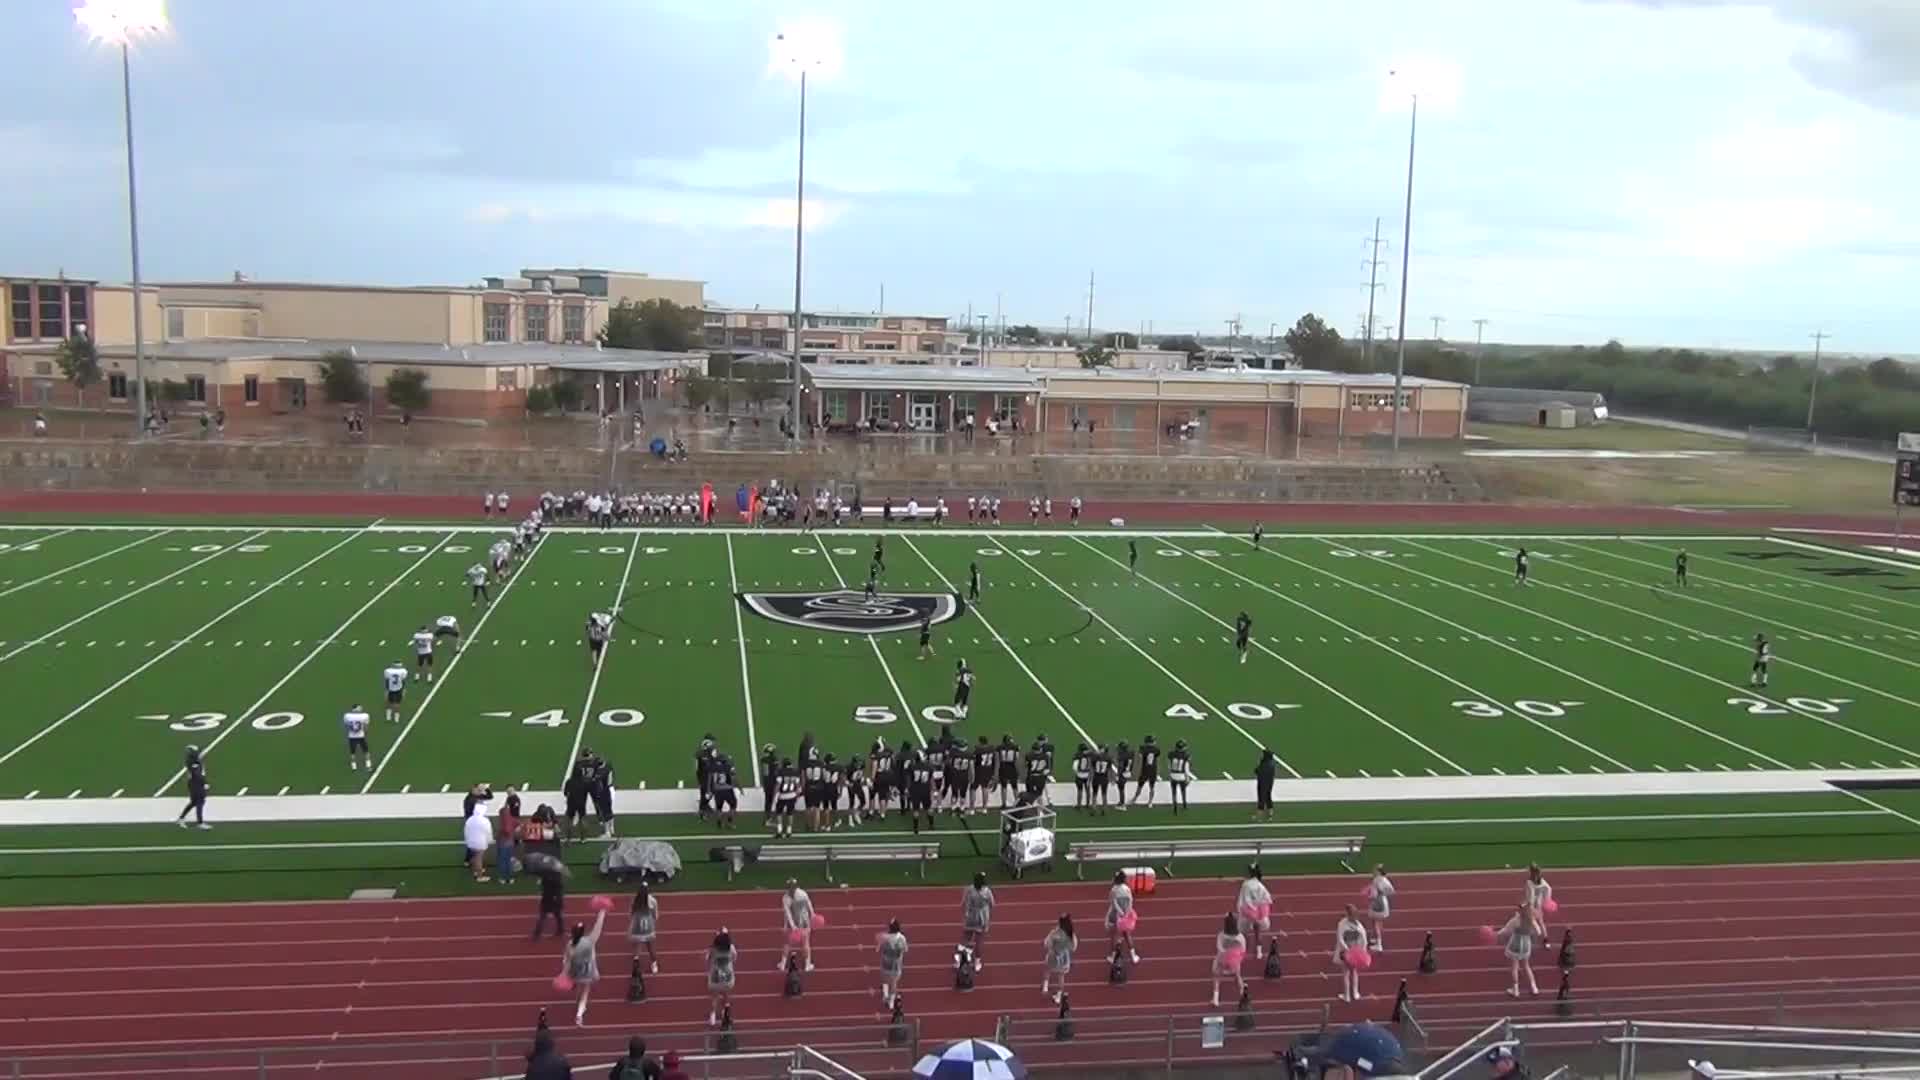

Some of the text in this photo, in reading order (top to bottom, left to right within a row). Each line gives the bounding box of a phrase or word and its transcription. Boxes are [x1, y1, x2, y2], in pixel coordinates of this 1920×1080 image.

[522, 708, 645, 728] 40
[854, 705, 967, 724] 50
[1164, 702, 1274, 721] 40
[1450, 700, 1566, 717] 30
[169, 711, 305, 731] 30
